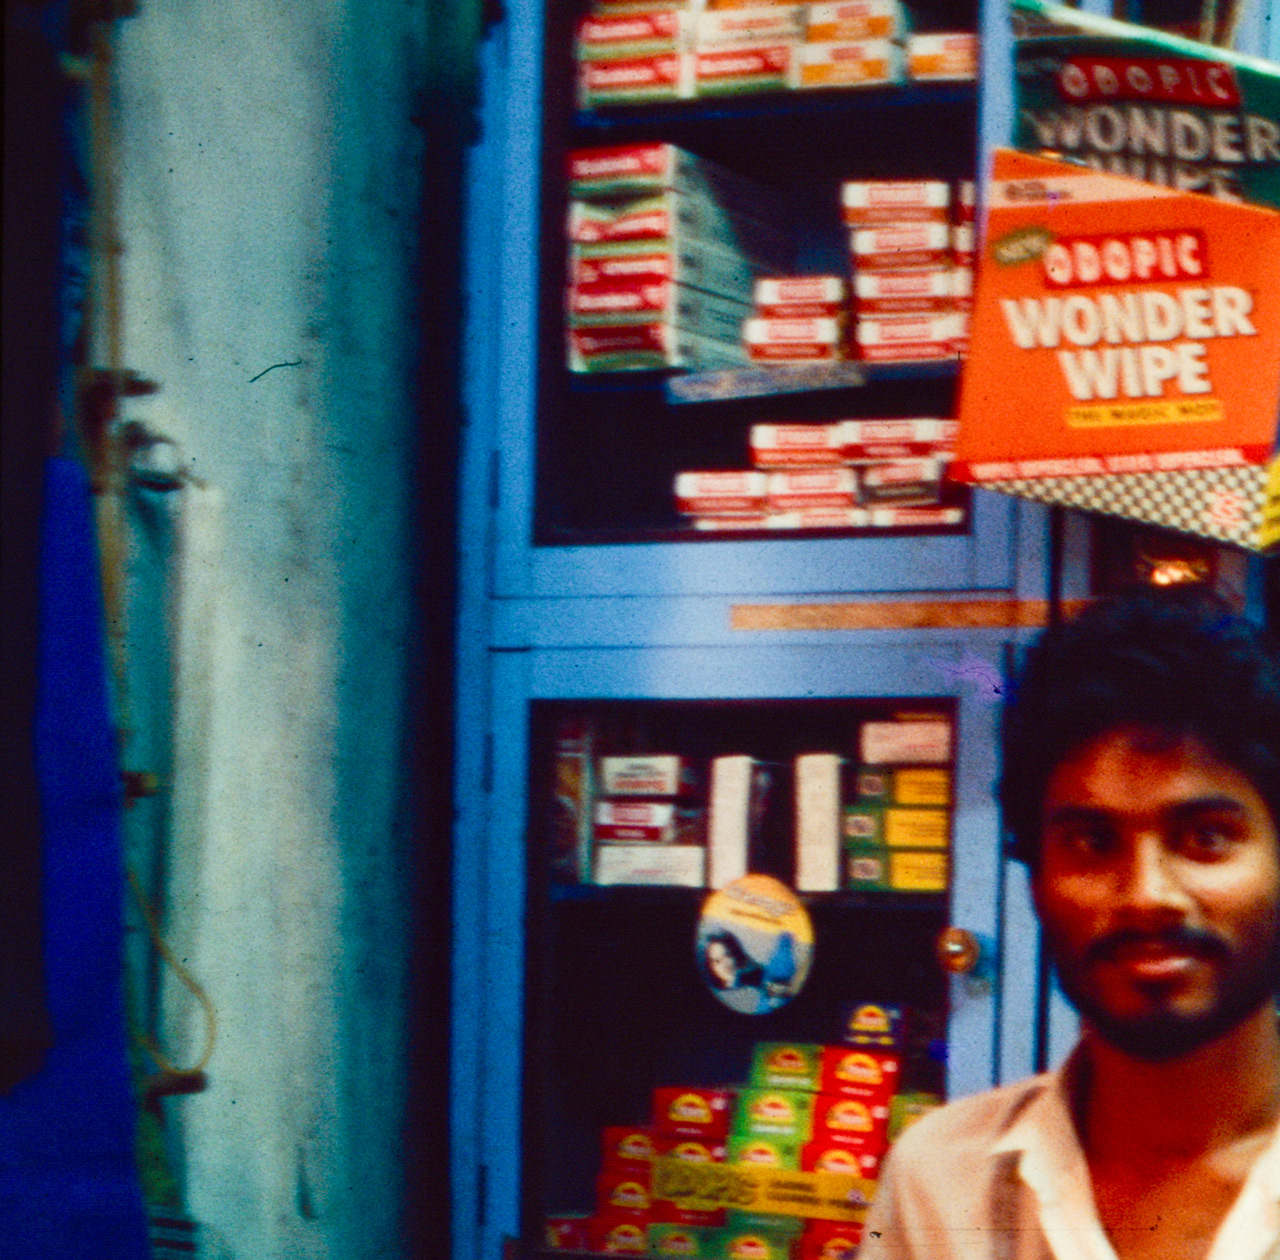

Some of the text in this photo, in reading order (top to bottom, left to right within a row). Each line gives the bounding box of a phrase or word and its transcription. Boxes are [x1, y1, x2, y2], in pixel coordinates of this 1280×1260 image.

[1044, 233, 1203, 285] ODOPIC
[1001, 286, 1258, 349] WONDER
[1057, 342, 1213, 400] WIPE
